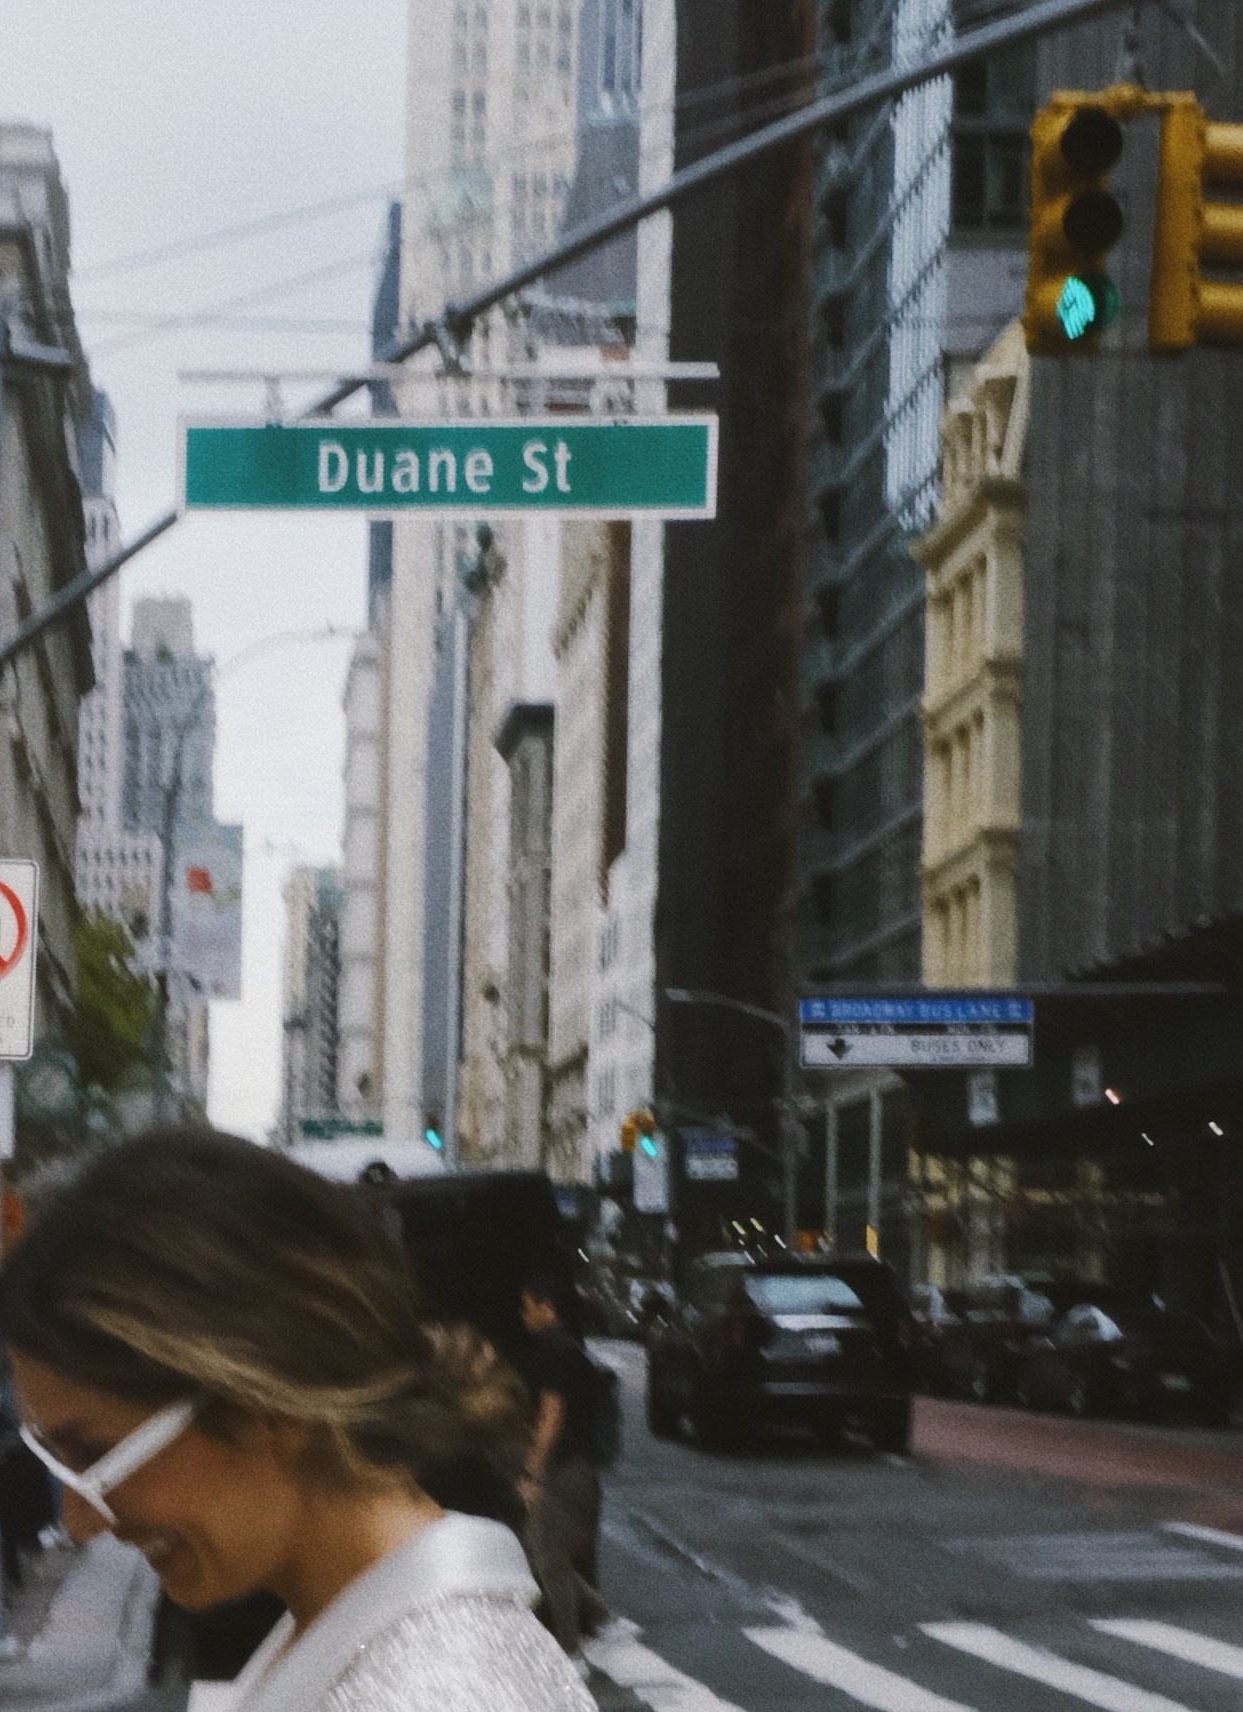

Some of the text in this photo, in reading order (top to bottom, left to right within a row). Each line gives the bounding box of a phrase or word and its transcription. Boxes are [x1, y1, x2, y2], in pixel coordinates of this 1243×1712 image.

[317, 438, 573, 493] Duane St
[830, 1002, 1002, 1019] BROADWAY BUS LANE
